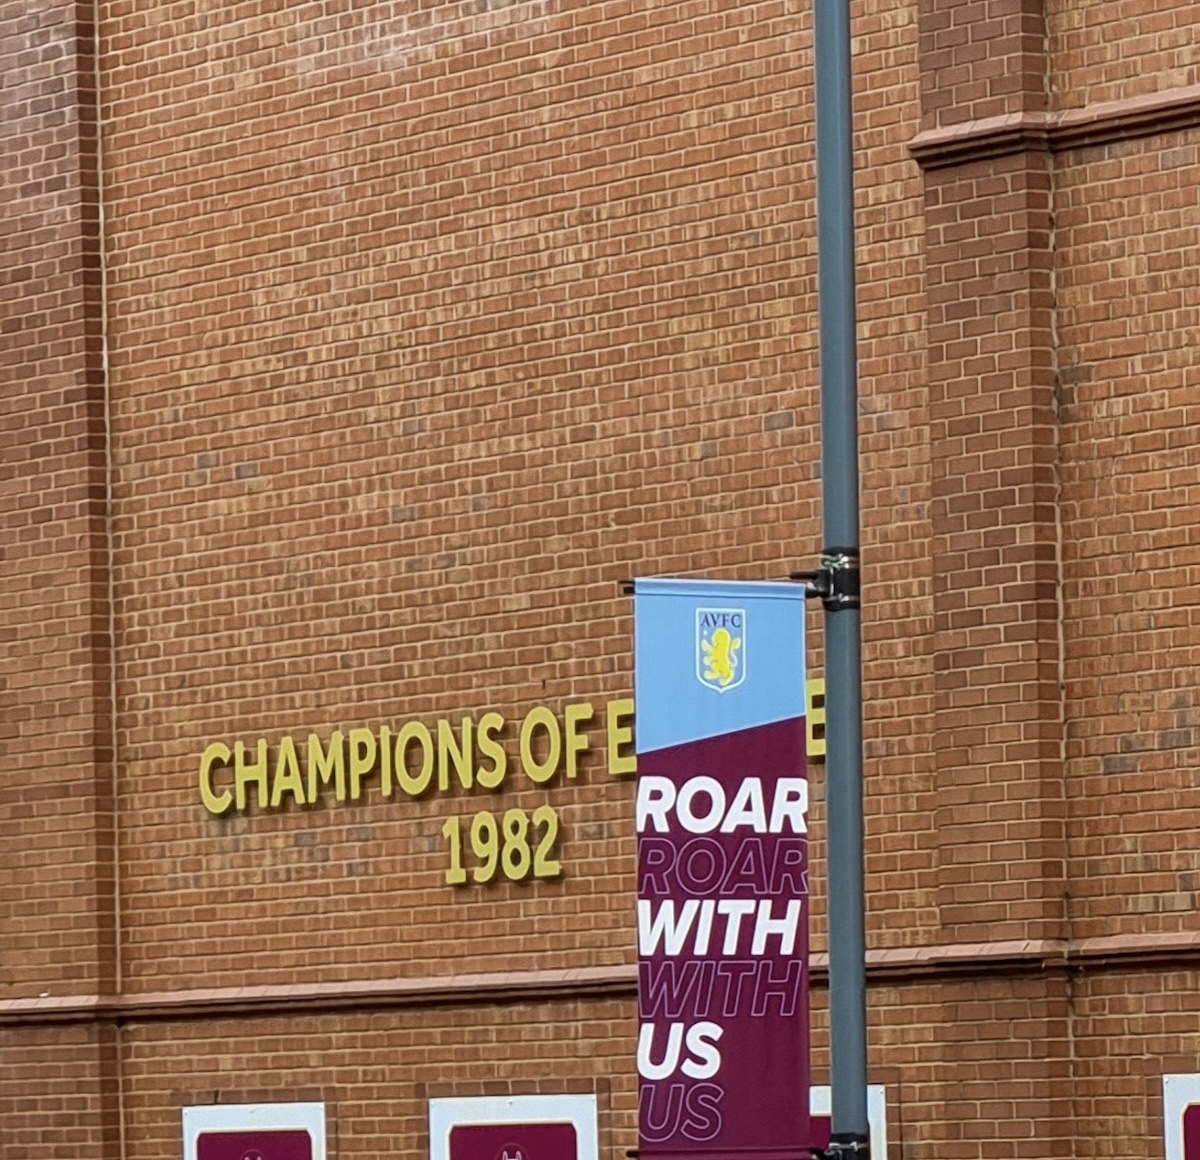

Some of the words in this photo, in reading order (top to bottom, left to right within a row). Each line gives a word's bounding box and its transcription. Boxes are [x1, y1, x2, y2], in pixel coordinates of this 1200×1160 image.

[701, 613, 742, 628] AVFC
[199, 711, 507, 814] CHAMPIONS
[520, 702, 594, 783] OF
[636, 775, 809, 834] ROAR
[442, 805, 563, 884] 1982
[637, 837, 809, 895] ROAR
[637, 899, 801, 956] WITH
[638, 959, 802, 1018] WITH
[636, 1021, 724, 1080] US
[638, 1082, 725, 1142] US
